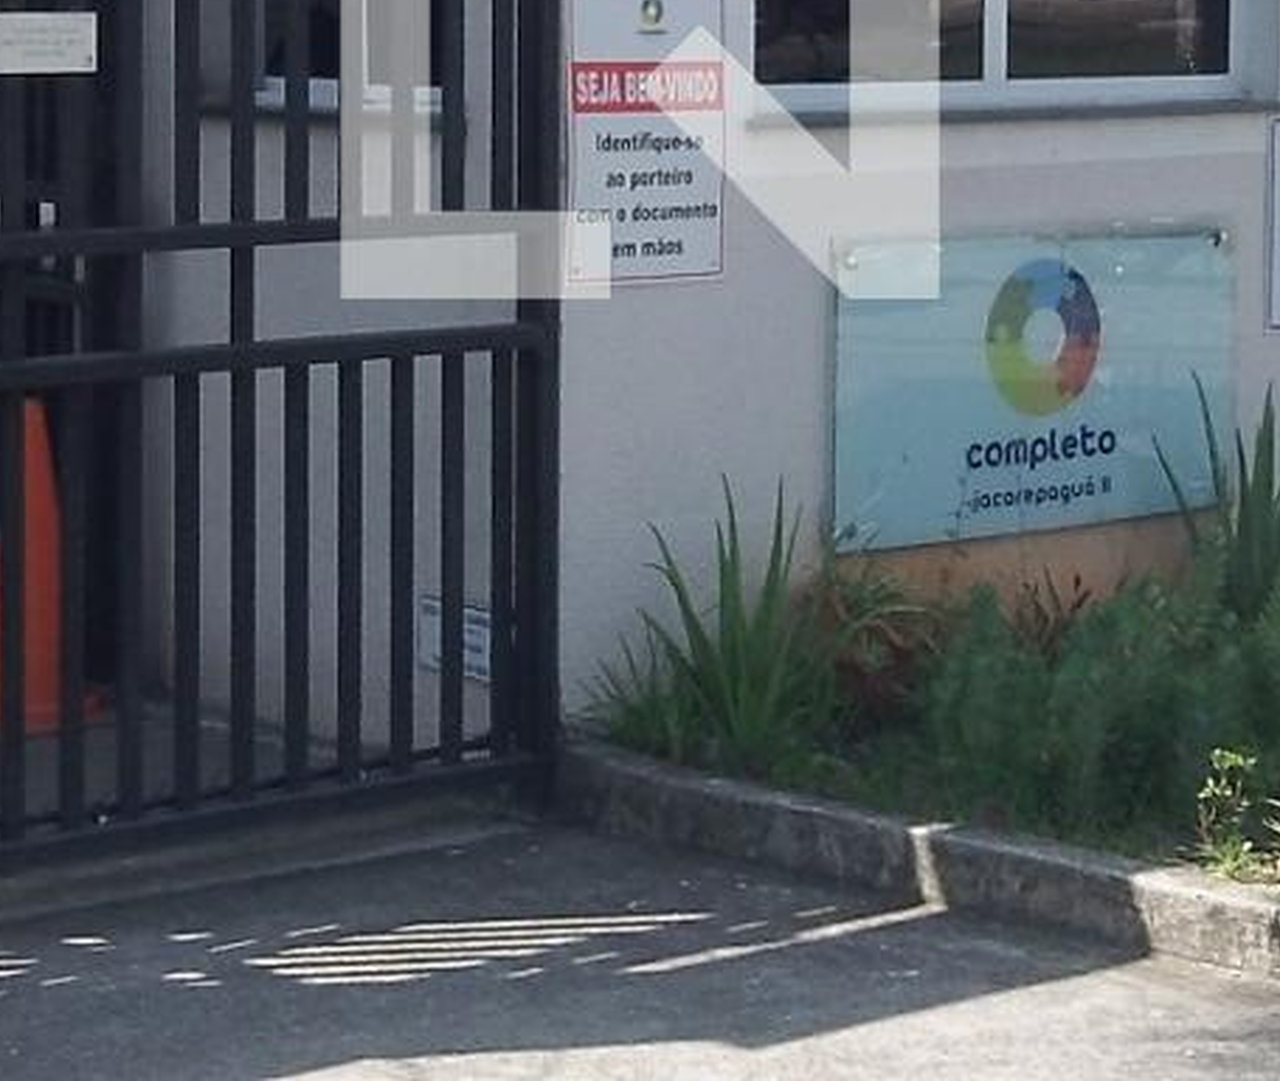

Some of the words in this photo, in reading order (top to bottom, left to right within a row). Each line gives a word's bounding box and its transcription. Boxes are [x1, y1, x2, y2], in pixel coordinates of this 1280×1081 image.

[576, 70, 622, 104] SEJA
[624, 69, 718, 103] BEM-VINDO
[606, 172, 625, 189] ao
[629, 168, 693, 191] porteiro
[616, 207, 627, 223] o
[631, 202, 718, 222] documento
[612, 242, 637, 258] em
[641, 239, 684, 256] mãos
[966, 423, 1117, 471] completo
[972, 474, 1096, 512] jacarepaguá
